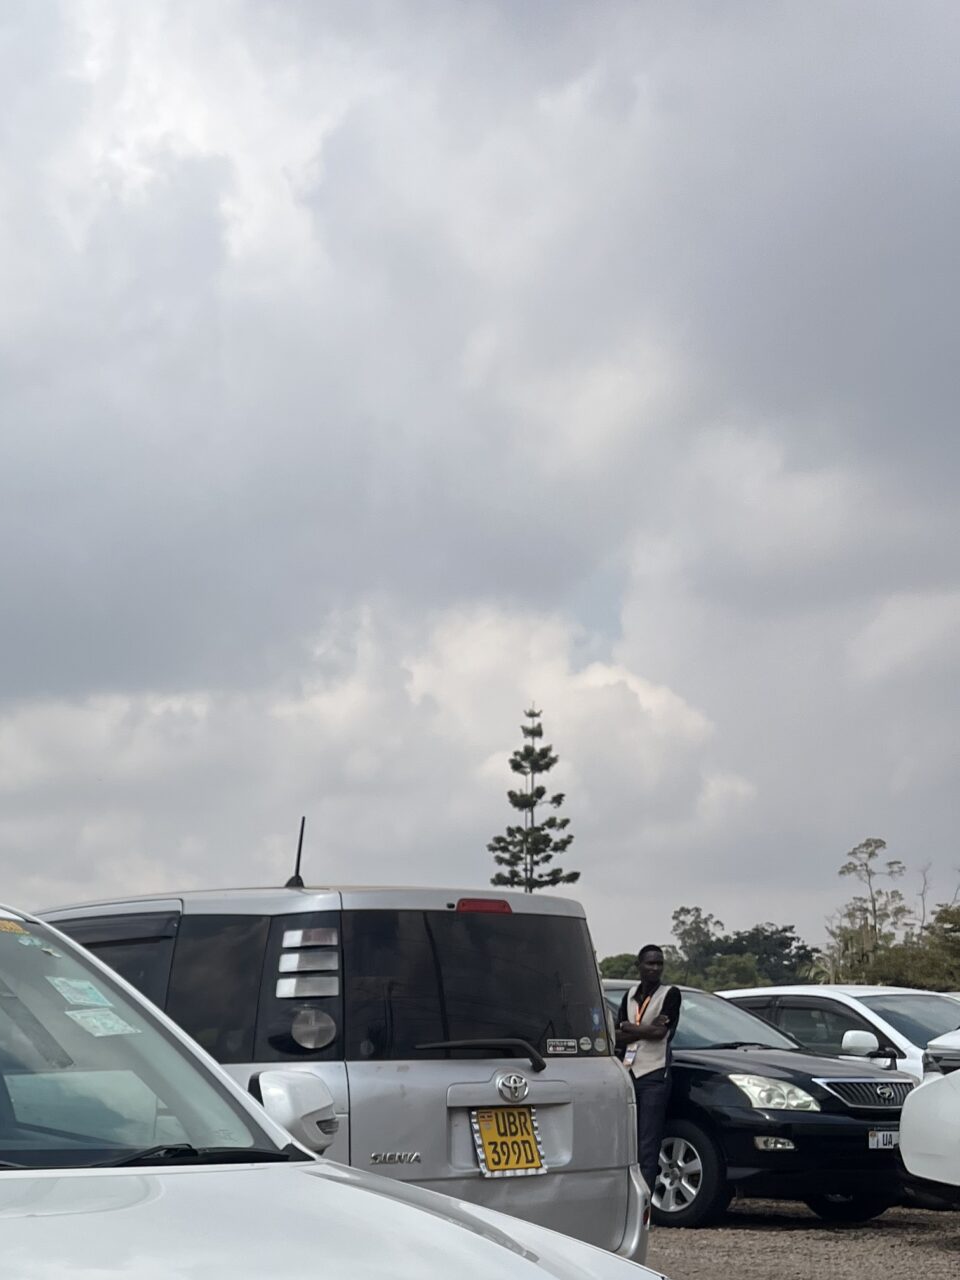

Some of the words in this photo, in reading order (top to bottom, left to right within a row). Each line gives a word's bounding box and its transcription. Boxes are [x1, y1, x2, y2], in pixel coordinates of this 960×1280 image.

[495, 1111, 531, 1137] UBR
[370, 1151, 421, 1165] SIENTA
[488, 1140, 535, 1166] 399D
